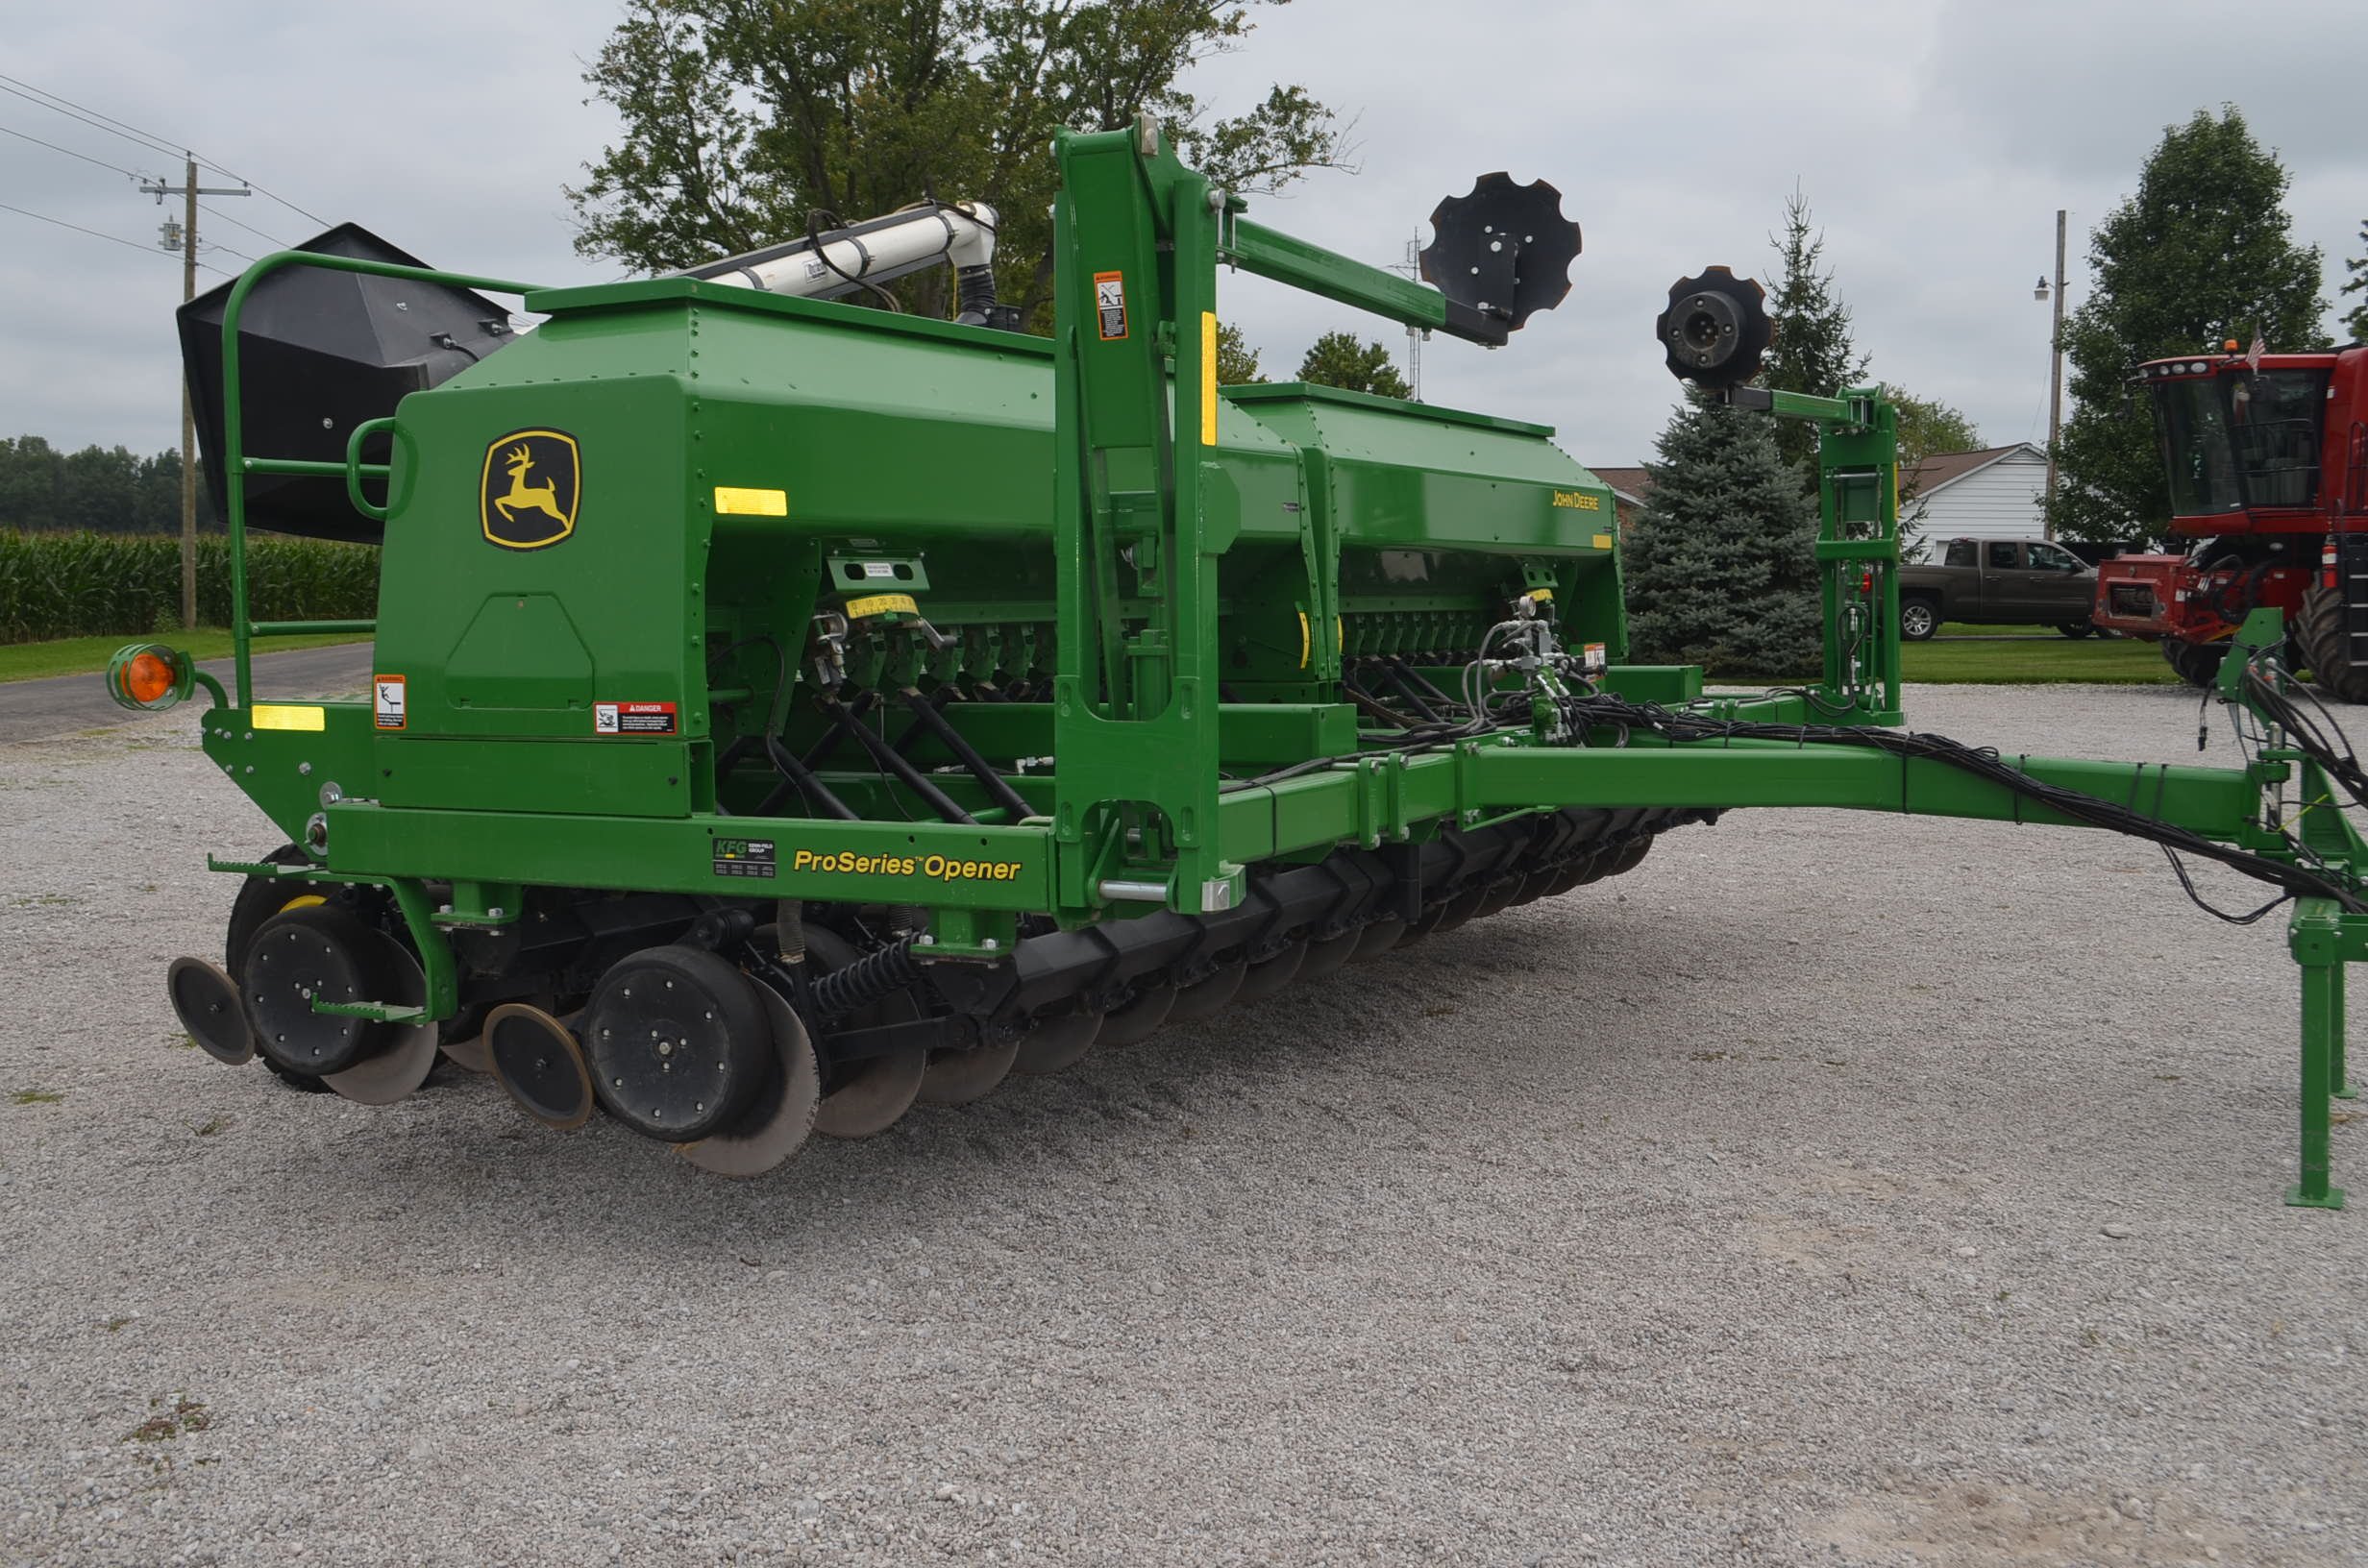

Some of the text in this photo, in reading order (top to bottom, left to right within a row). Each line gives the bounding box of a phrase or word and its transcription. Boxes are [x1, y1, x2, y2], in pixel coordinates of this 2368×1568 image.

[1553, 490, 1599, 510] JOHN DEERE
[716, 840, 747, 854] KFG
[924, 854, 1022, 881] Opener
